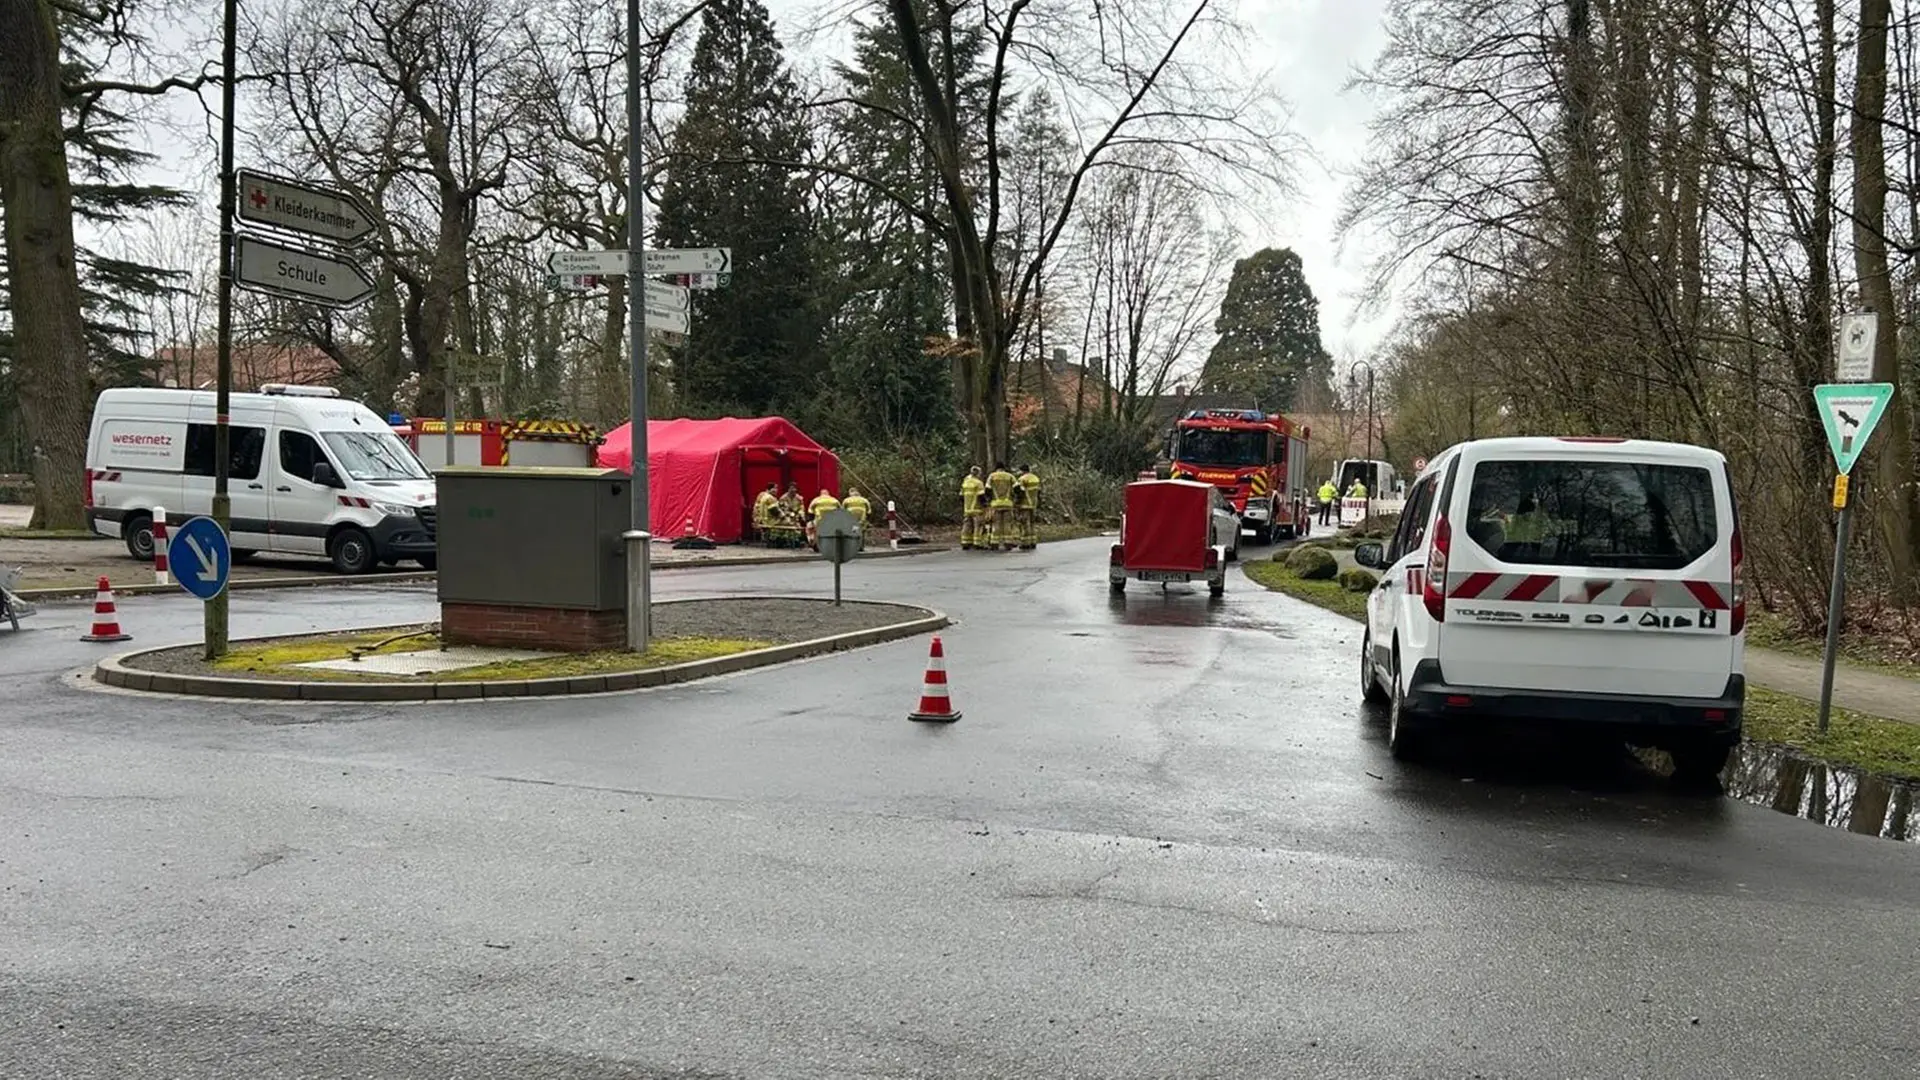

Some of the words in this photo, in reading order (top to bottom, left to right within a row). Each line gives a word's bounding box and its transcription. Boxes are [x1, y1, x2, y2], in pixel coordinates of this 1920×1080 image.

[275, 196, 356, 229] Kleiderkammer
[653, 252, 681, 262] Bremen
[278, 261, 326, 285] Schule
[112, 435, 171, 445] wesernetz
[1197, 471, 1237, 480] FEUERWEHR
